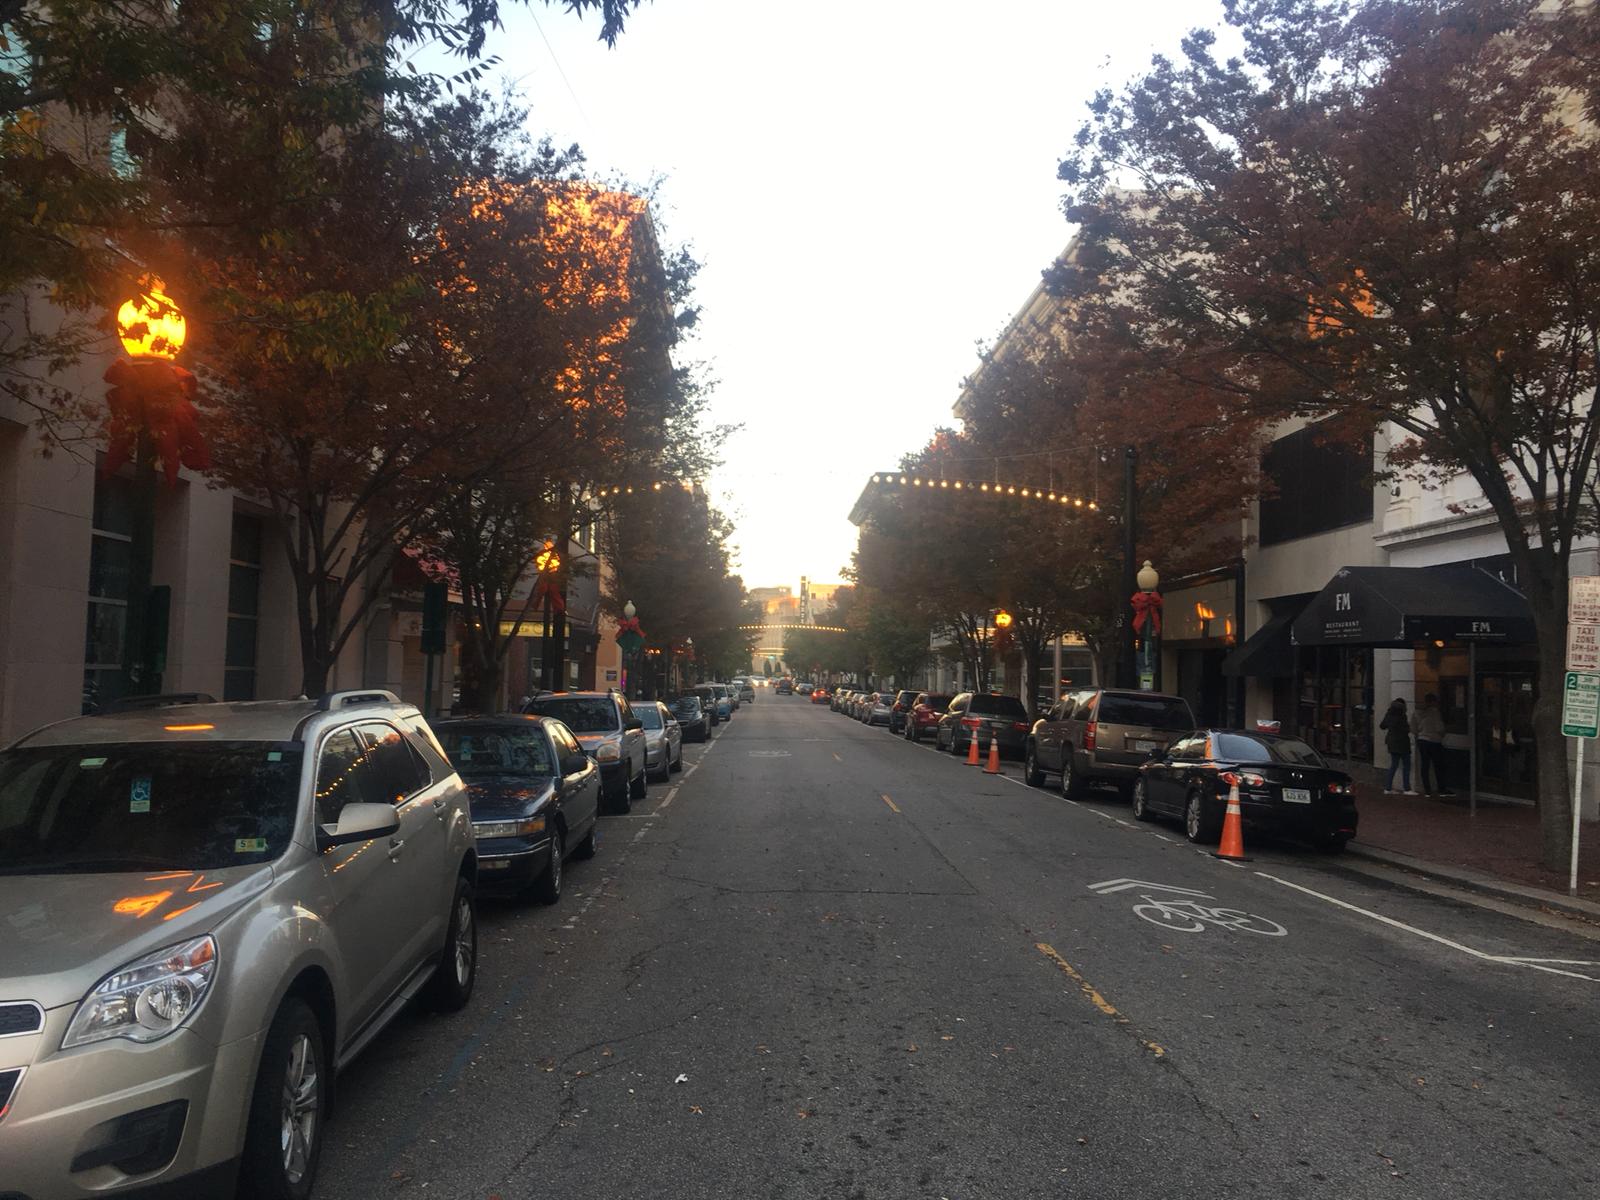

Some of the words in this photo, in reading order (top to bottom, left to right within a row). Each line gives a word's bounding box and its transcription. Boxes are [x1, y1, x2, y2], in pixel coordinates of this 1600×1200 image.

[1336, 592, 1351, 611] FM
[1326, 620, 1359, 629] RESTAURANT
[1471, 621, 1491, 632] FM
[1577, 627, 1595, 635] TAXI
[1575, 635, 1595, 644] ZONE
[1568, 676, 1577, 688] 2
